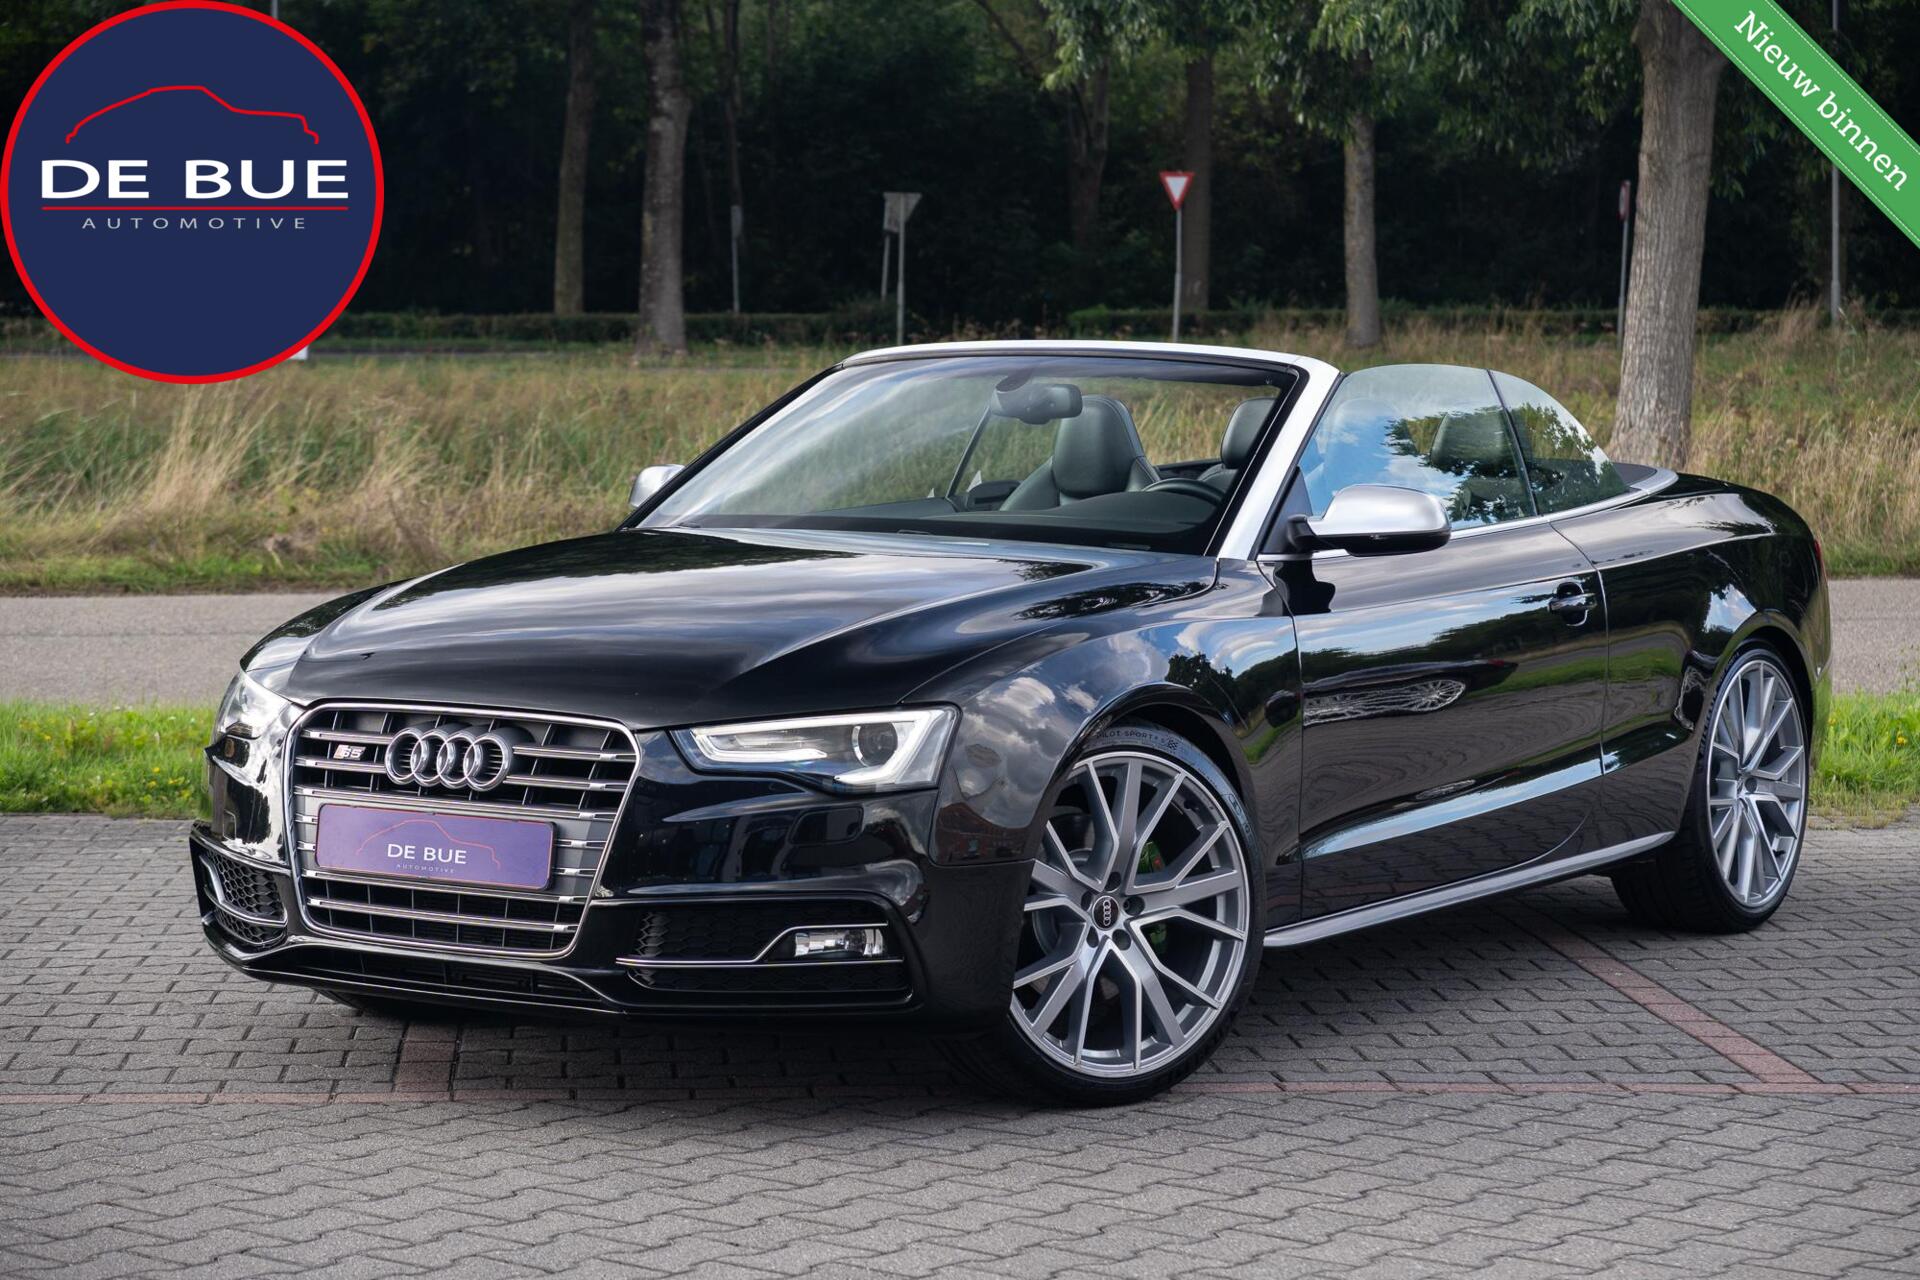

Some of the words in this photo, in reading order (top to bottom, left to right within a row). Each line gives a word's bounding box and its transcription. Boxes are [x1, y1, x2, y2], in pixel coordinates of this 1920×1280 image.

[387, 843, 416, 860] DE
[423, 846, 467, 865] BUE
[396, 863, 455, 874] AUTOMOTIVE
